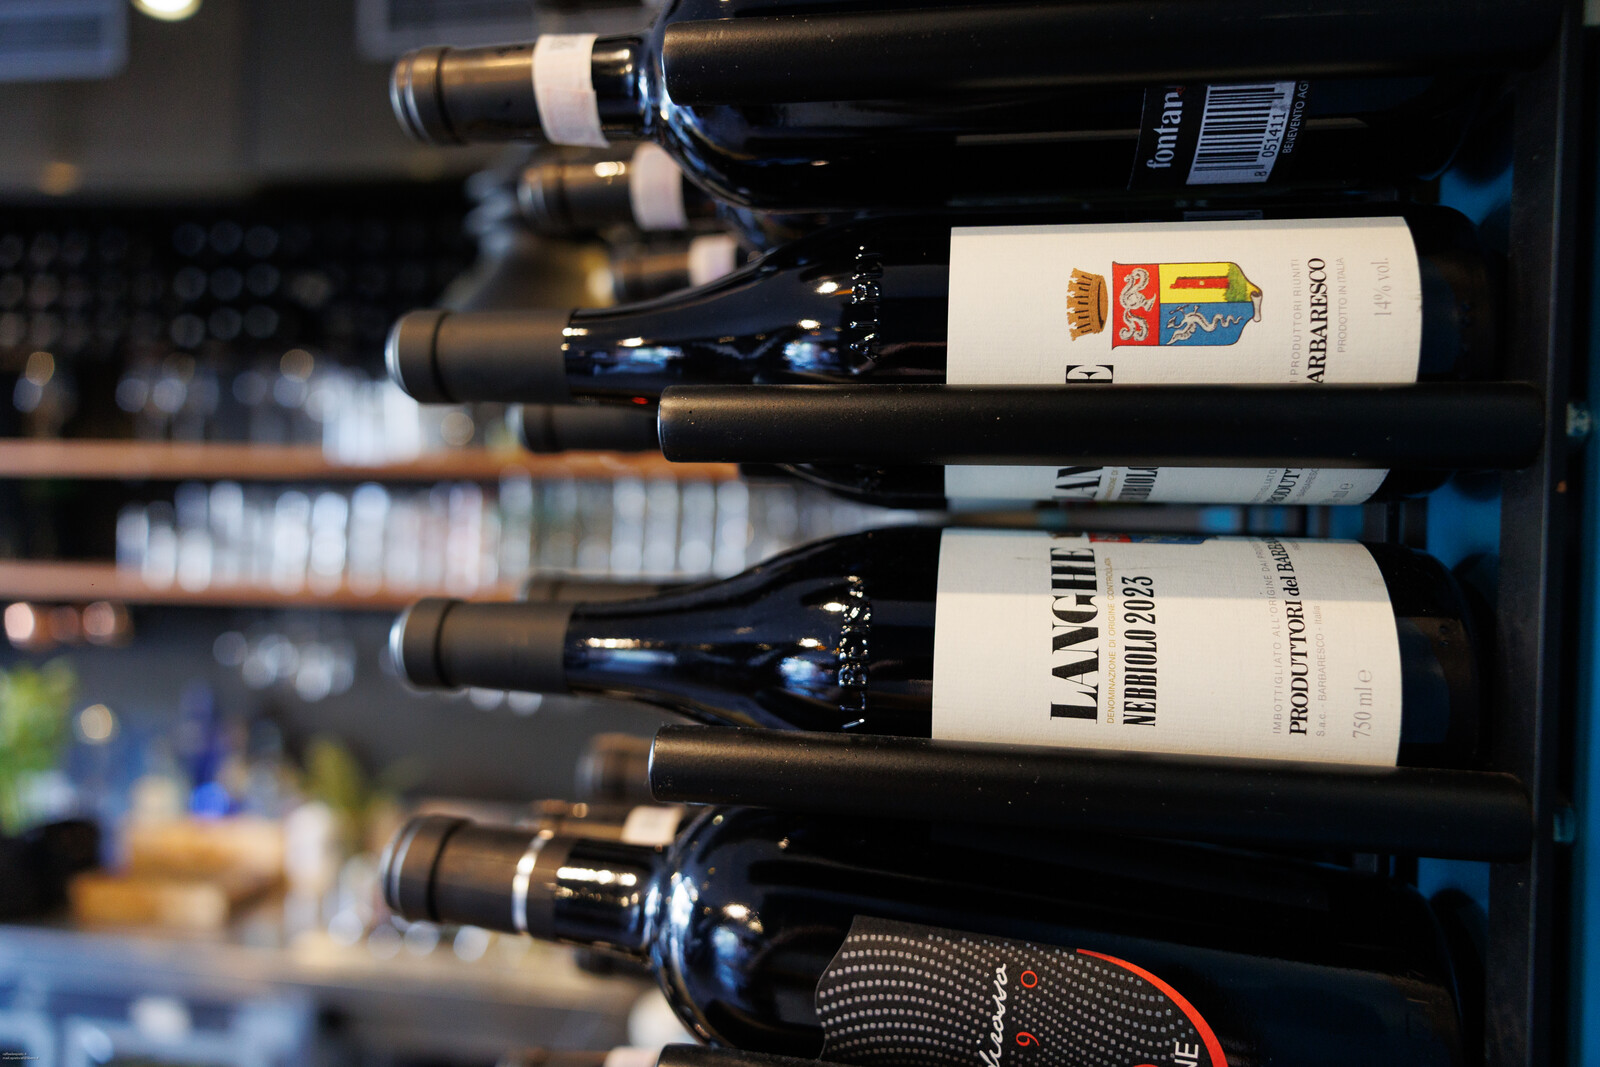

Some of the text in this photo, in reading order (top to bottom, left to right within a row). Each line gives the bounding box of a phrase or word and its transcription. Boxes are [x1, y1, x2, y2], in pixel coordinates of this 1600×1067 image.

[1261, 112, 1286, 158] 051411
[1282, 81, 1309, 154] BENEVENTO AG
[1291, 258, 1302, 299] RIUNITI
[1336, 257, 1348, 353] PRODOTTO IN ITALIA
[1370, 257, 1392, 316] 14% vol.
[1290, 301, 1303, 376] PRODUTTORI
[1306, 257, 1328, 384] ARBARESCO
[1107, 603, 1116, 636] ORIGINE
[1280, 576, 1300, 597] del
[1312, 605, 1322, 625] Italia
[1050, 547, 1099, 724] LANGHE
[1108, 639, 1117, 648] DI
[1121, 576, 1157, 727] NEBBIOLO 2023
[1260, 560, 1285, 735] IMBOTTIGLIATO ALL'ORIGINE DAI
[1285, 600, 1309, 736] PRODUTTORI
[1316, 633, 1327, 702] BARBARESCO
[1106, 651, 1117, 724] DENOMINAZIONE
[1354, 686, 1373, 707] ml
[1352, 710, 1373, 739] 750
